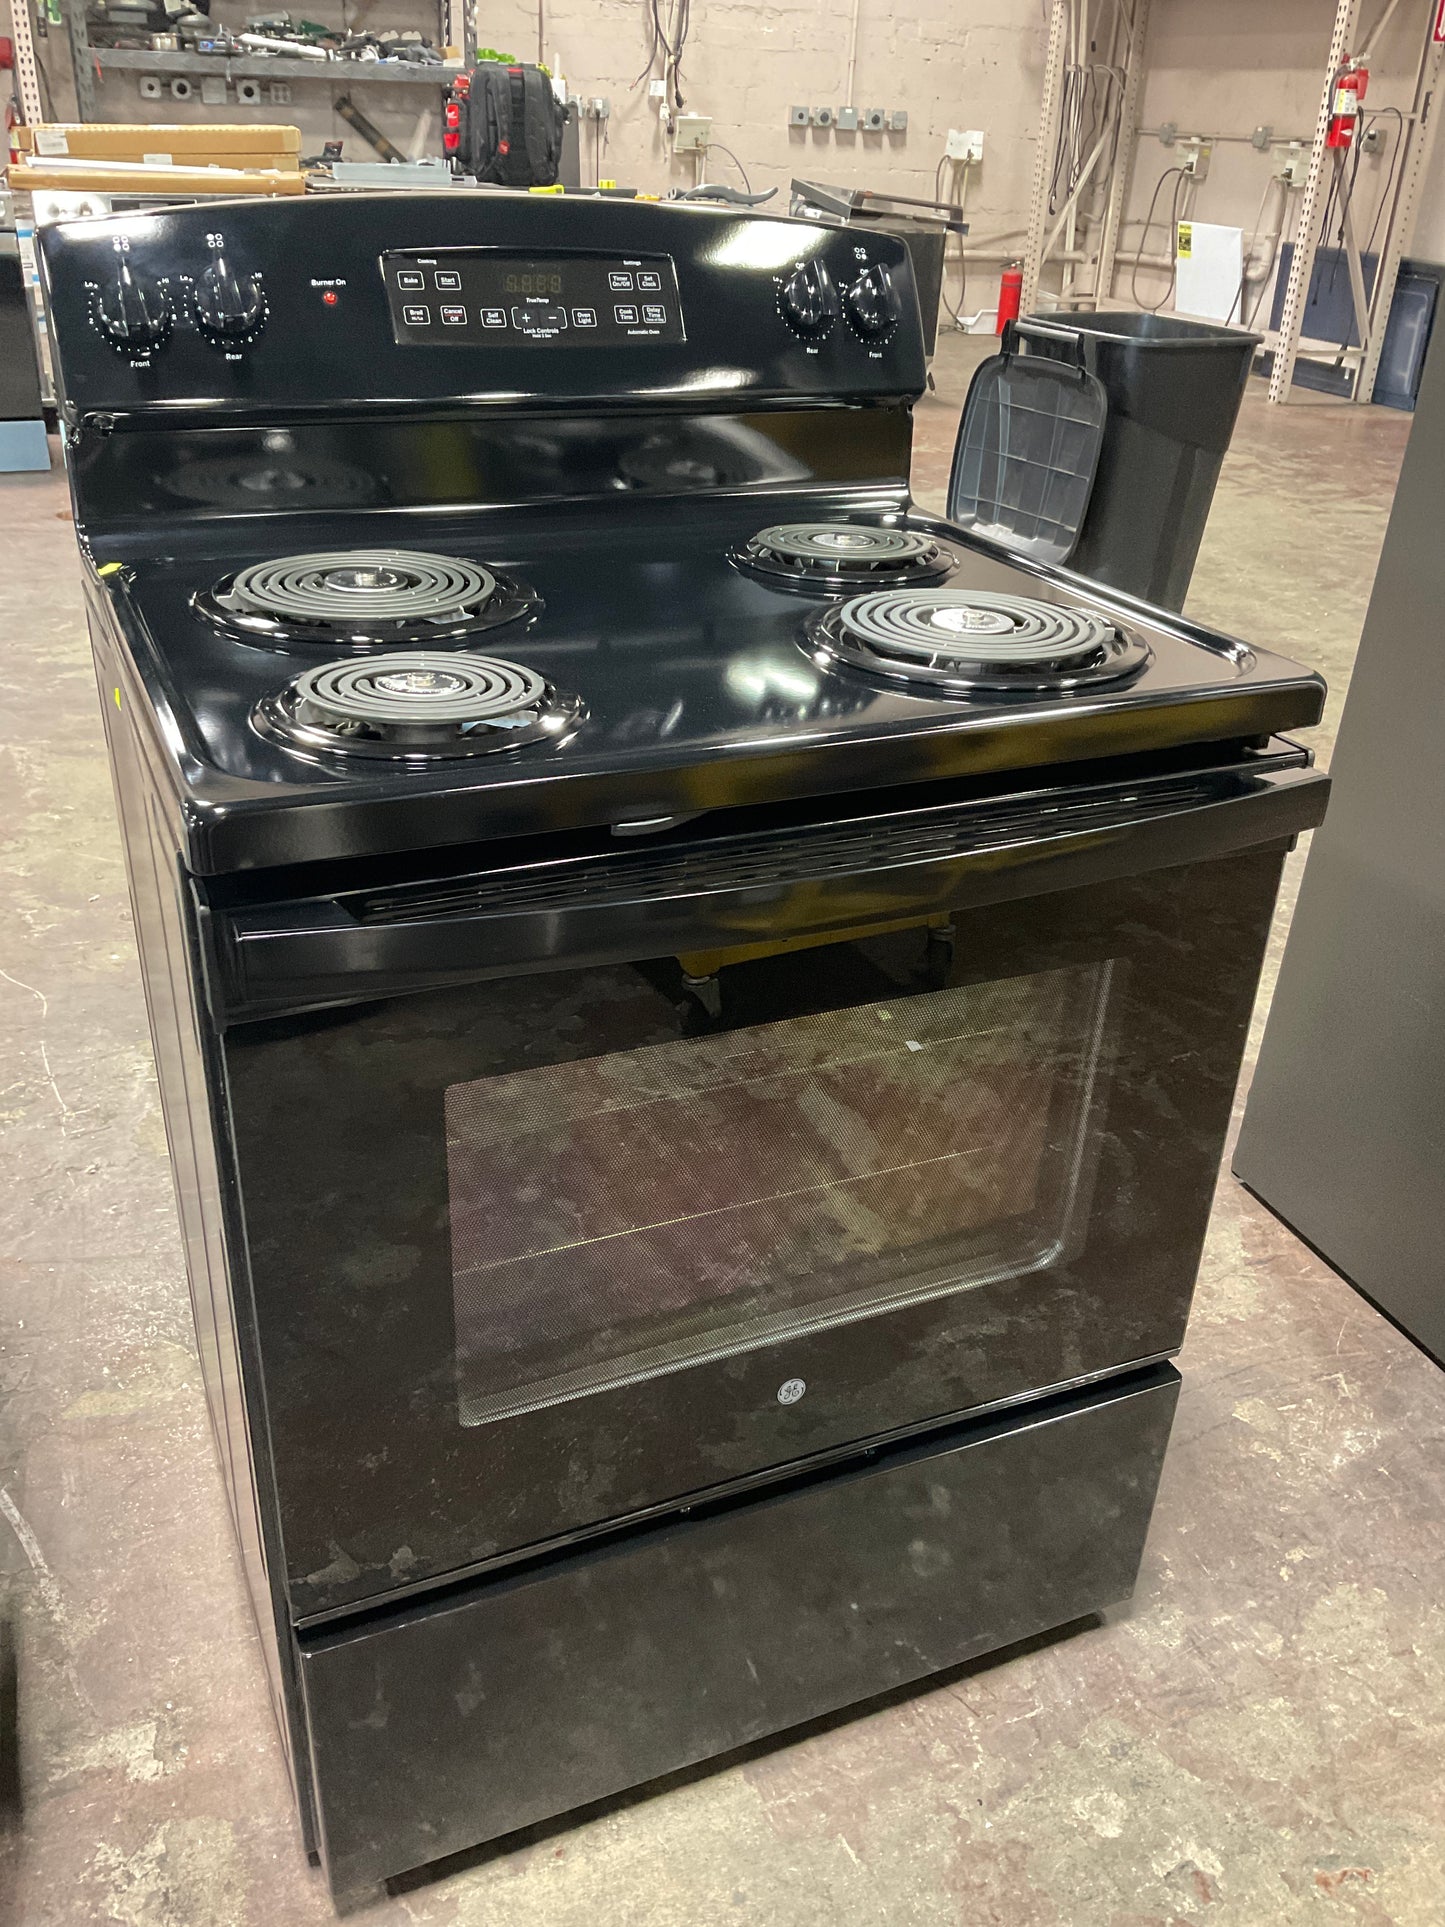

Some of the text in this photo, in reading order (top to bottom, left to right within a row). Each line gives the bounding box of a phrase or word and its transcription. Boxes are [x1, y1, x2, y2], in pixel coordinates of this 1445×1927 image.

[335, 278, 347, 286] On
[440, 276, 456, 284] Start
[578, 317, 592, 325] Light
[225, 353, 243, 361] Rear
[868, 351, 883, 359] Front
[130, 360, 151, 368] Front
